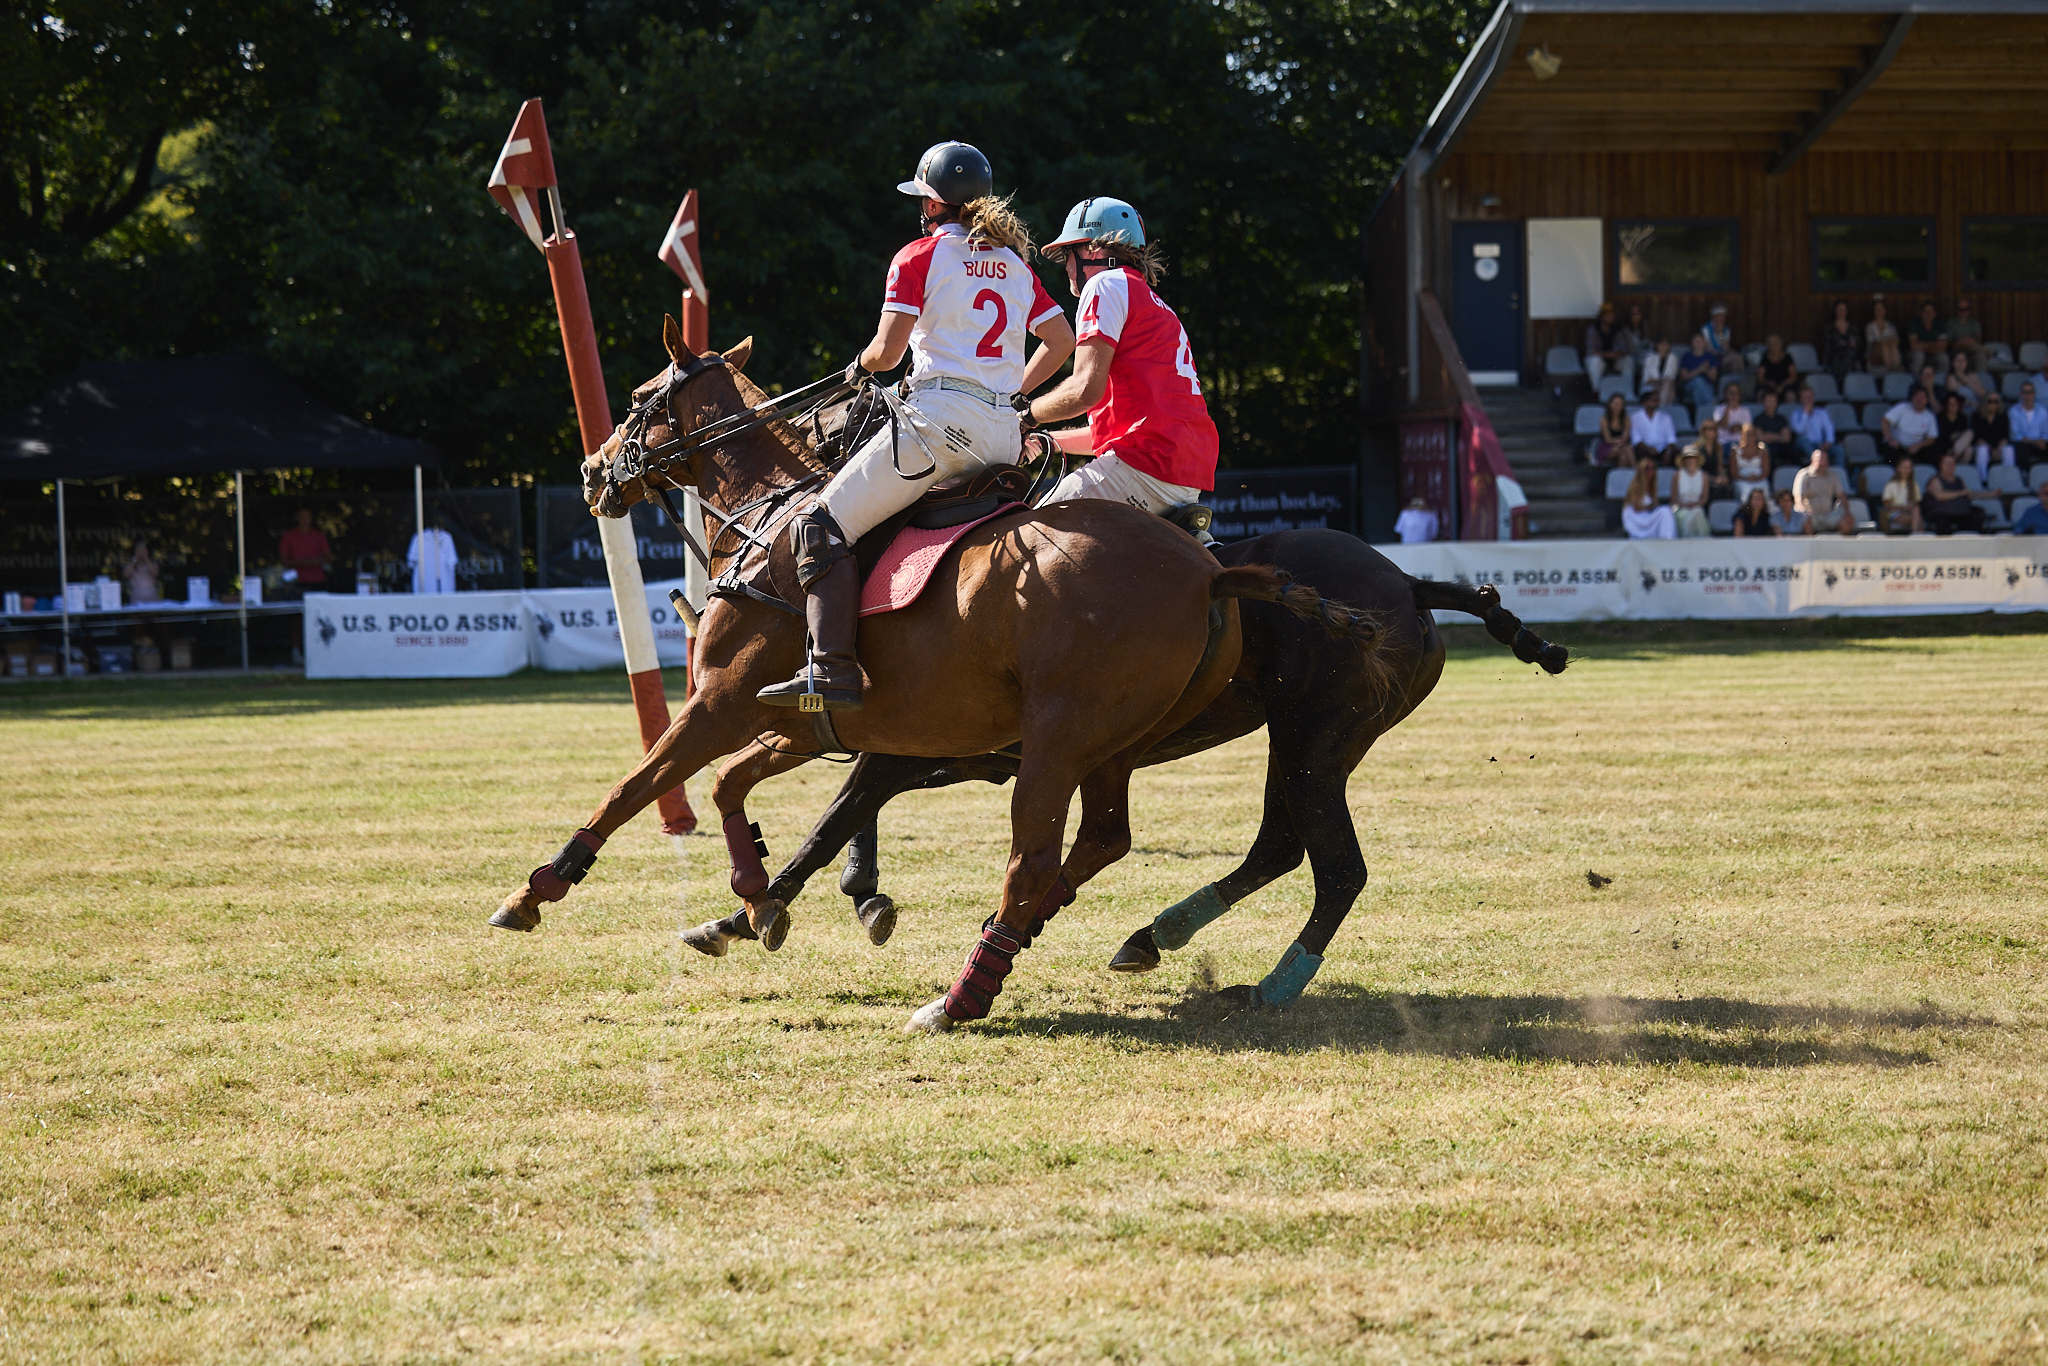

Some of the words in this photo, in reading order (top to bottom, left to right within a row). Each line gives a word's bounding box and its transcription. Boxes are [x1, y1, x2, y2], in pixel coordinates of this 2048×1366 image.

[963, 261, 1007, 279] BUUS
[886, 264, 900, 298] 2
[1082, 295, 1100, 326] 4
[973, 288, 1008, 358] 2
[1176, 322, 1201, 396] 4
[571, 537, 604, 561] Po
[1513, 570, 1563, 585] POLO
[1567, 569, 1620, 583] ASSN.
[1660, 568, 1692, 583] U.S.
[1698, 567, 1748, 582] POLO
[1753, 566, 1804, 582] ASSN.
[1844, 566, 1874, 580] U.S.
[1881, 565, 1928, 580] POLO
[1933, 565, 1986, 580] ASSN.
[342, 614, 381, 633] U.S.
[388, 614, 448, 632] POLO
[456, 614, 522, 632] ASSN.
[560, 609, 599, 628] U.S.
[606, 608, 667, 626] PO
[395, 635, 434, 648] SINCE
